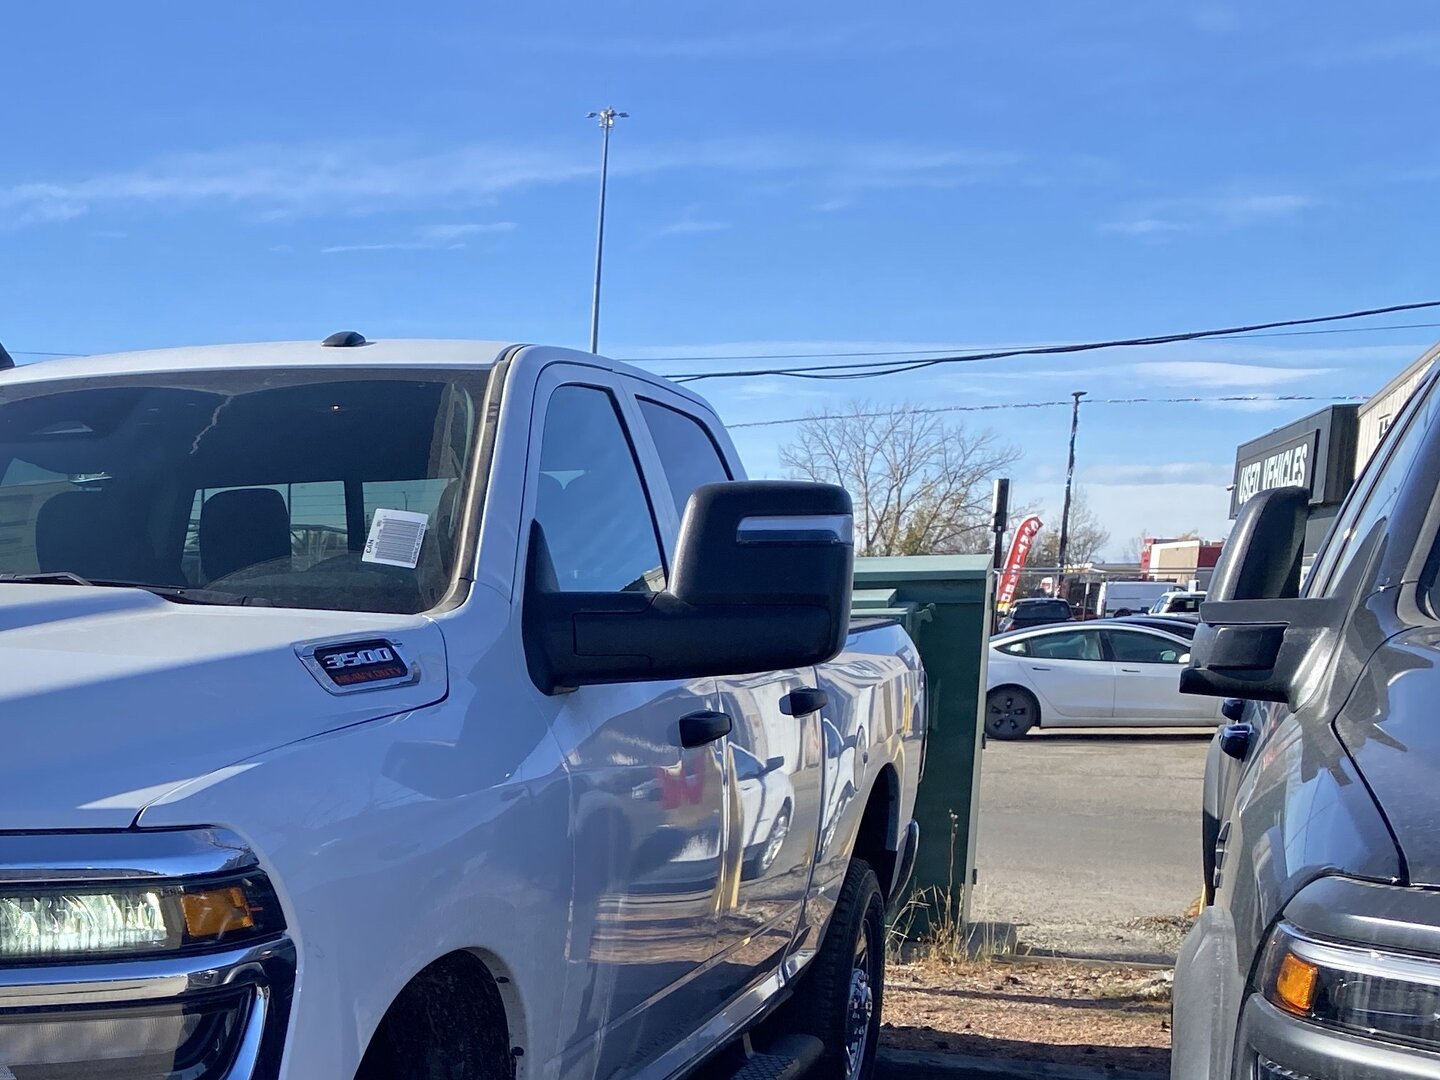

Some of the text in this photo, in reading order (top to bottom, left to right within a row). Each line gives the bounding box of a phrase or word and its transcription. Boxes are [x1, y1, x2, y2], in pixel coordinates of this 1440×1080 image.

[1239, 443, 1308, 505] USED VEHICLES
[323, 647, 394, 670] 3500
